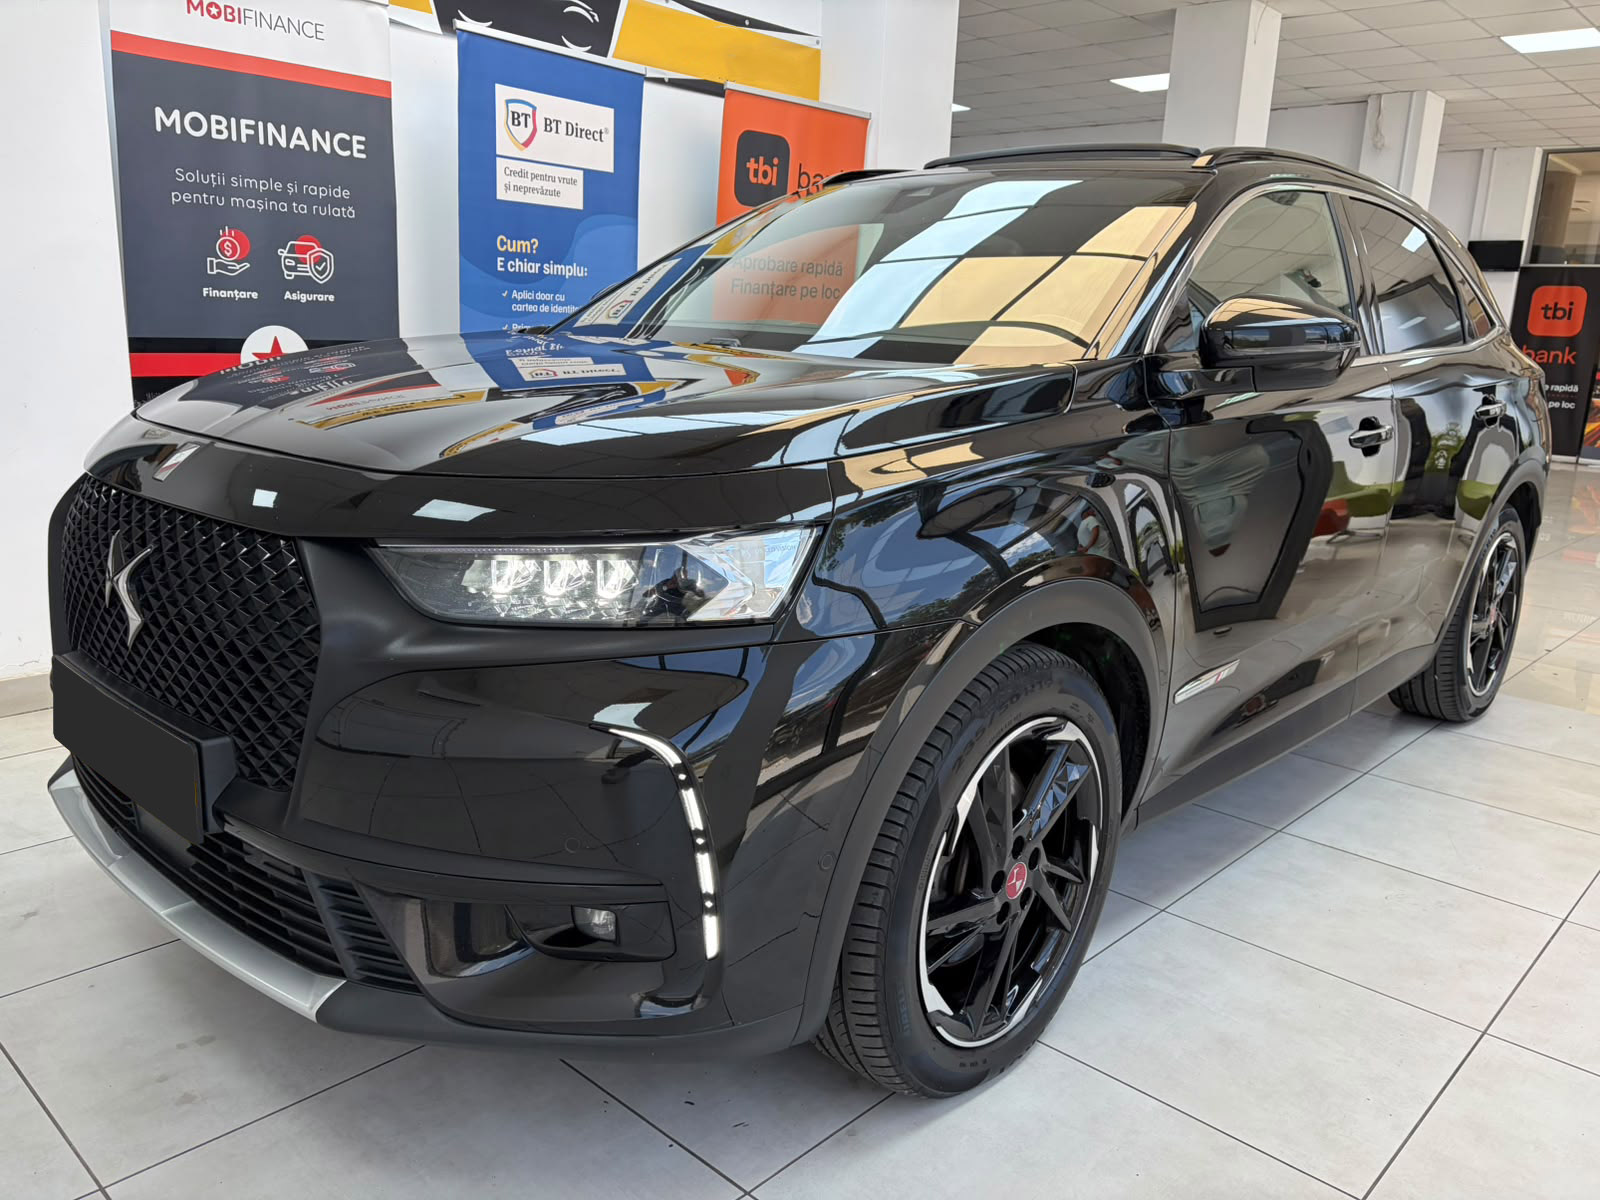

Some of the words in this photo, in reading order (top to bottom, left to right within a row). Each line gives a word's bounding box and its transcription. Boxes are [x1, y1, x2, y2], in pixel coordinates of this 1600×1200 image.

[186, 0, 325, 41] MOBIFINANCE
[510, 110, 531, 128] BT
[543, 117, 562, 134] BT
[154, 106, 367, 159] MOBIFINANCE
[504, 166, 530, 179] Credit
[530, 173, 557, 183] pentru
[557, 177, 578, 186] vrute
[746, 156, 779, 186] tbi
[175, 168, 225, 188] Soluții
[230, 174, 283, 192] simple
[287, 181, 298, 195] și
[303, 184, 351, 199] rapide
[504, 181, 512, 193] și
[513, 185, 561, 198] neprevăzute
[171, 191, 225, 205] pentru
[230, 197, 288, 213] mașina
[292, 201, 308, 214] ta
[312, 203, 356, 218] rulată
[497, 235, 539, 254] Cum?
[497, 257, 505, 272] E
[507, 258, 541, 274] chiar
[543, 260, 588, 279] simplu:
[800, 260, 843, 278] rapidă
[202, 287, 259, 300] Finanțare
[284, 291, 335, 303] Asigurare
[511, 289, 535, 301] Aplici
[535, 291, 554, 301] doar
[554, 293, 565, 301] cu
[800, 285, 818, 301] pe
[821, 283, 840, 300] loc
[511, 303, 538, 312] cartea
[539, 303, 550, 312] de
[1541, 301, 1574, 320] tbi
[1550, 384, 1579, 393] rapidă
[1548, 401, 1560, 409] pe
[1561, 401, 1576, 409] loc
